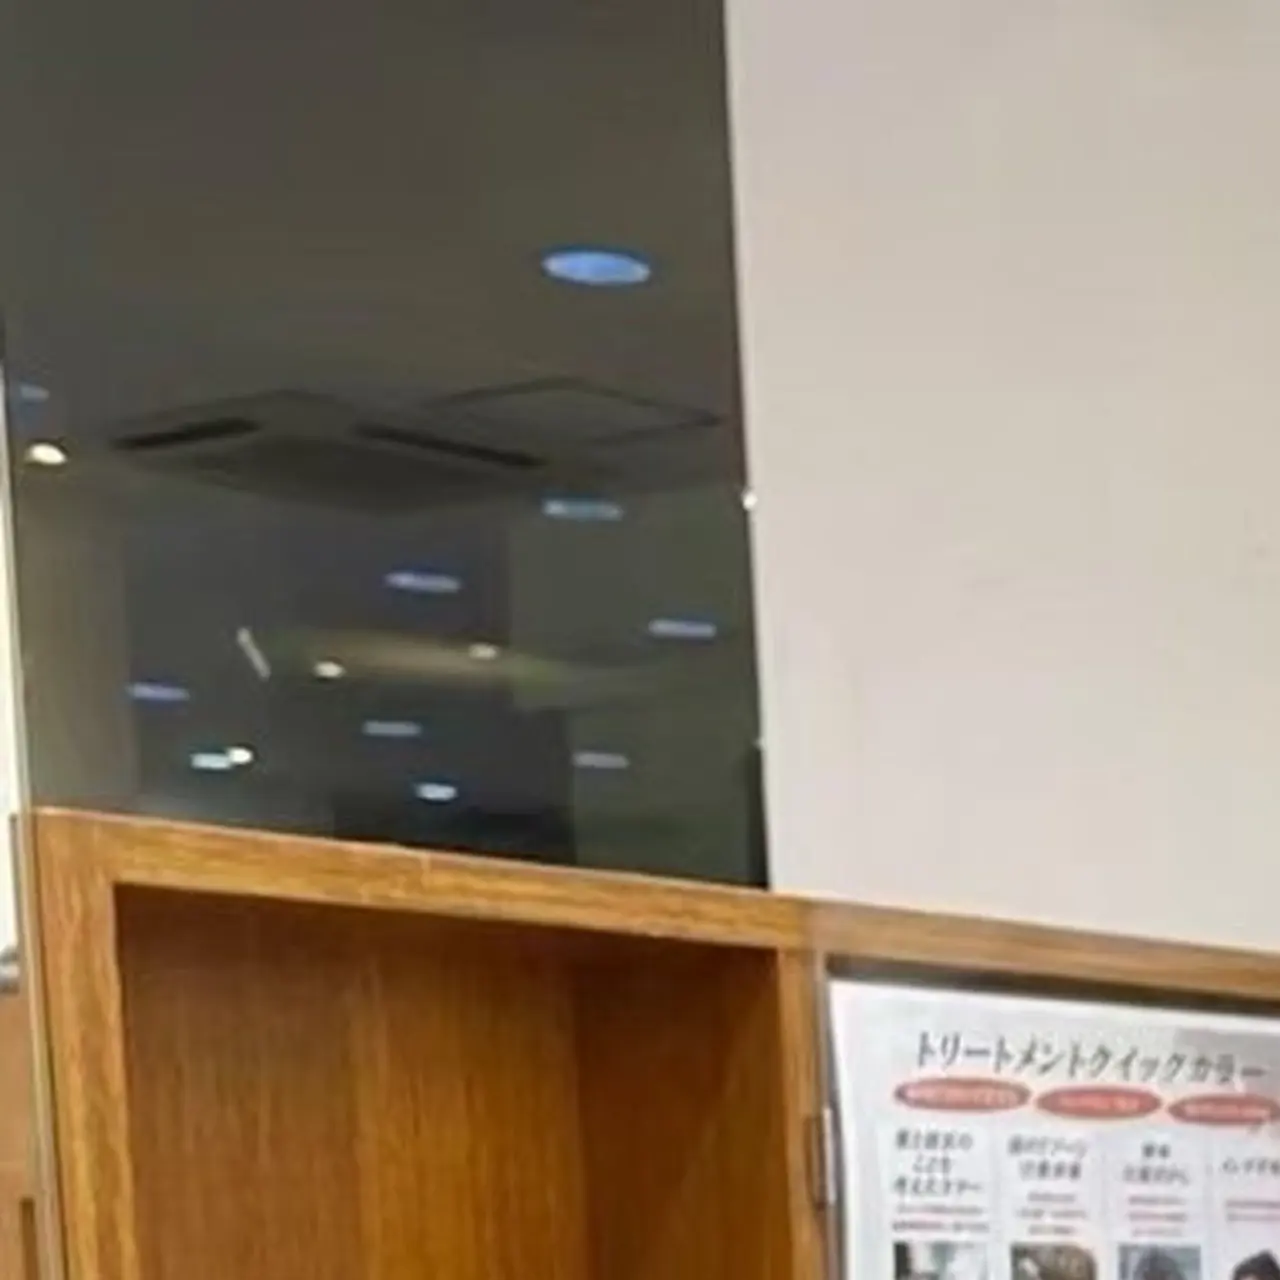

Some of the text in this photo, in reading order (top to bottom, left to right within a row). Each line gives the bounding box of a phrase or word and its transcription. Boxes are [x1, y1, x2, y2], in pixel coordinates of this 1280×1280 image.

[917, 1030, 1267, 1084] トリートメントクイックカラー
